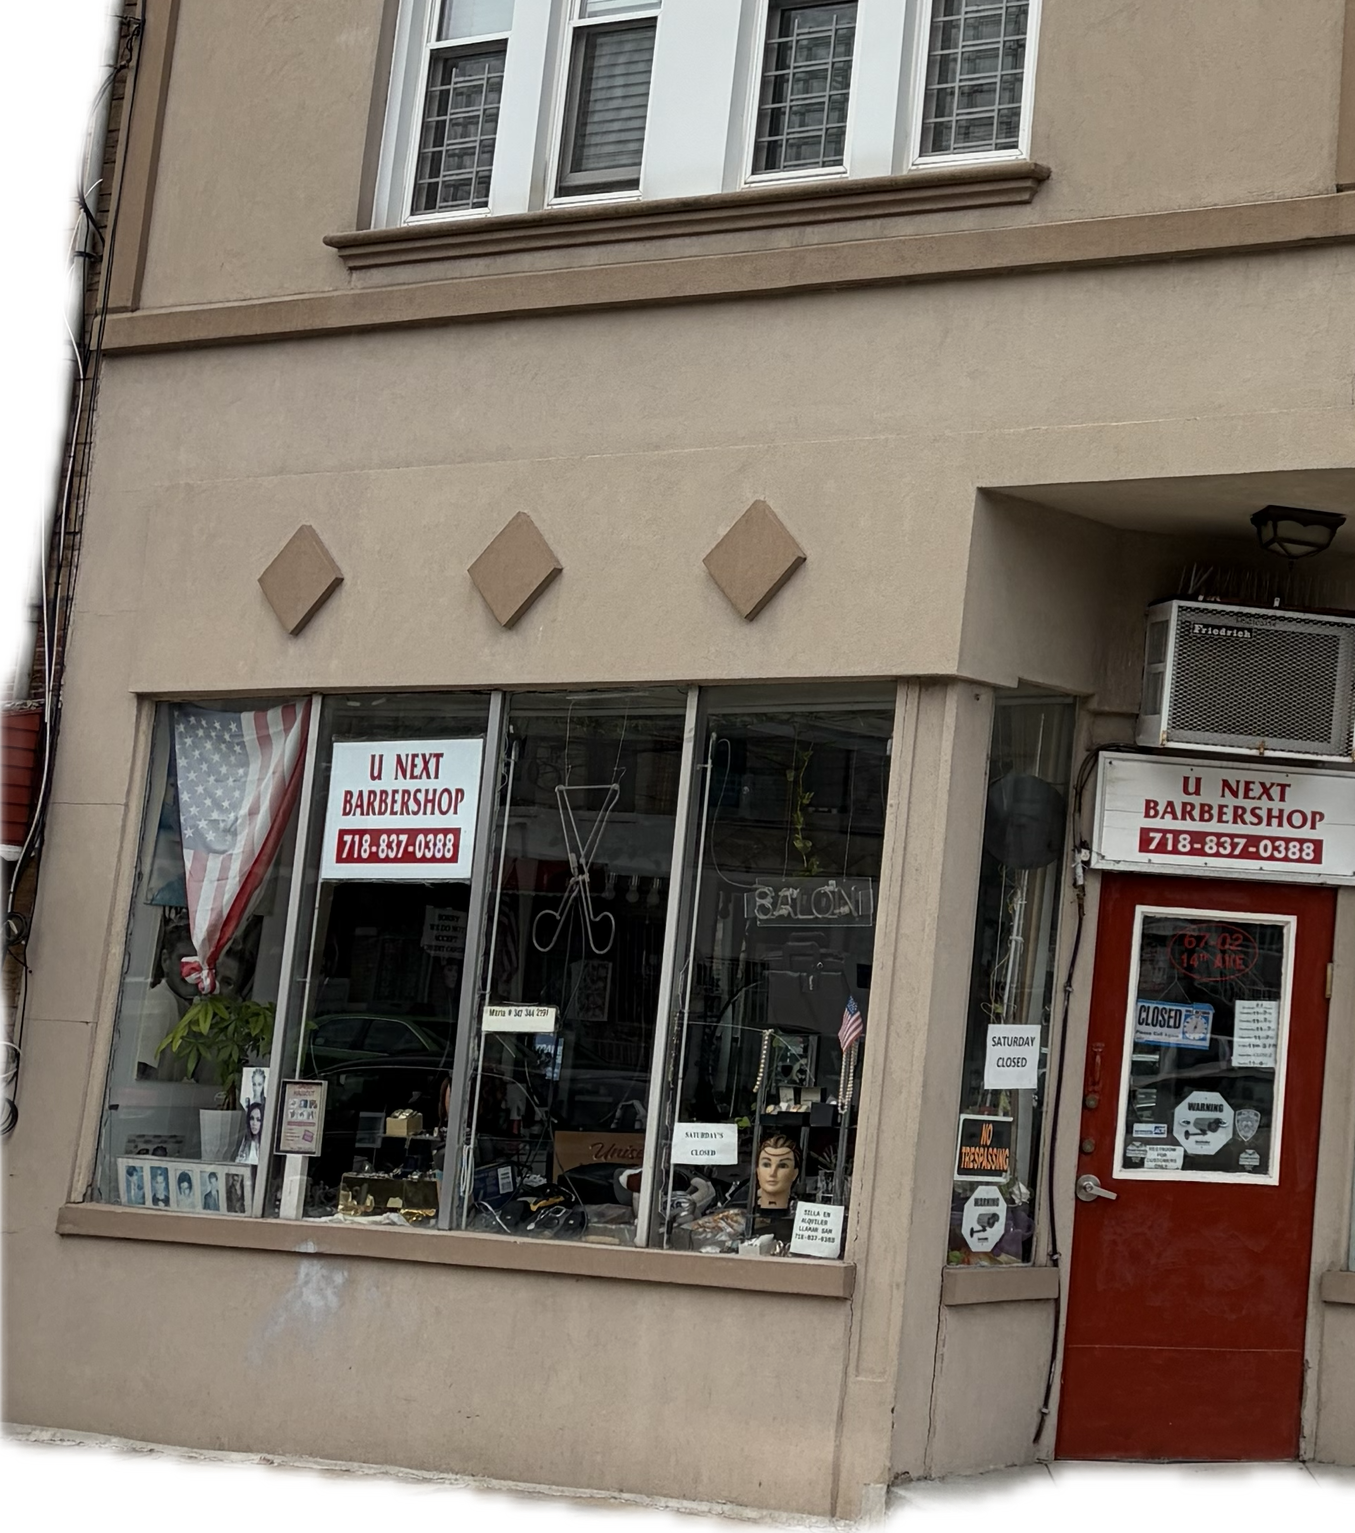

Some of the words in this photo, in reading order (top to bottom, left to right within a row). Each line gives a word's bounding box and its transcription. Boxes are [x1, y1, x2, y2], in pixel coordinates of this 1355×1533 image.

[1193, 624, 1251, 638] Friedrich
[369, 754, 384, 781] U
[394, 752, 445, 780] NEXT
[1182, 776, 1202, 796] U
[1220, 779, 1291, 803] NEXT
[341, 787, 465, 817] BARBERSHOP
[1143, 798, 1325, 830] BARBERSHOP
[341, 833, 455, 859] 718-837-0388
[1148, 832, 1315, 861] 718-837-0388
[1183, 932, 1244, 950] 67-02
[1137, 1004, 1182, 1030] CLOSED
[991, 1036, 1036, 1048] SATURDAY
[996, 1056, 1028, 1068] CLOSED
[1187, 1102, 1224, 1113] WARNING
[980, 1123, 993, 1146] NO
[690, 1149, 716, 1157] CLOSED
[960, 1146, 1010, 1171] TRESPASSING
[973, 1197, 1000, 1207] WARNING
